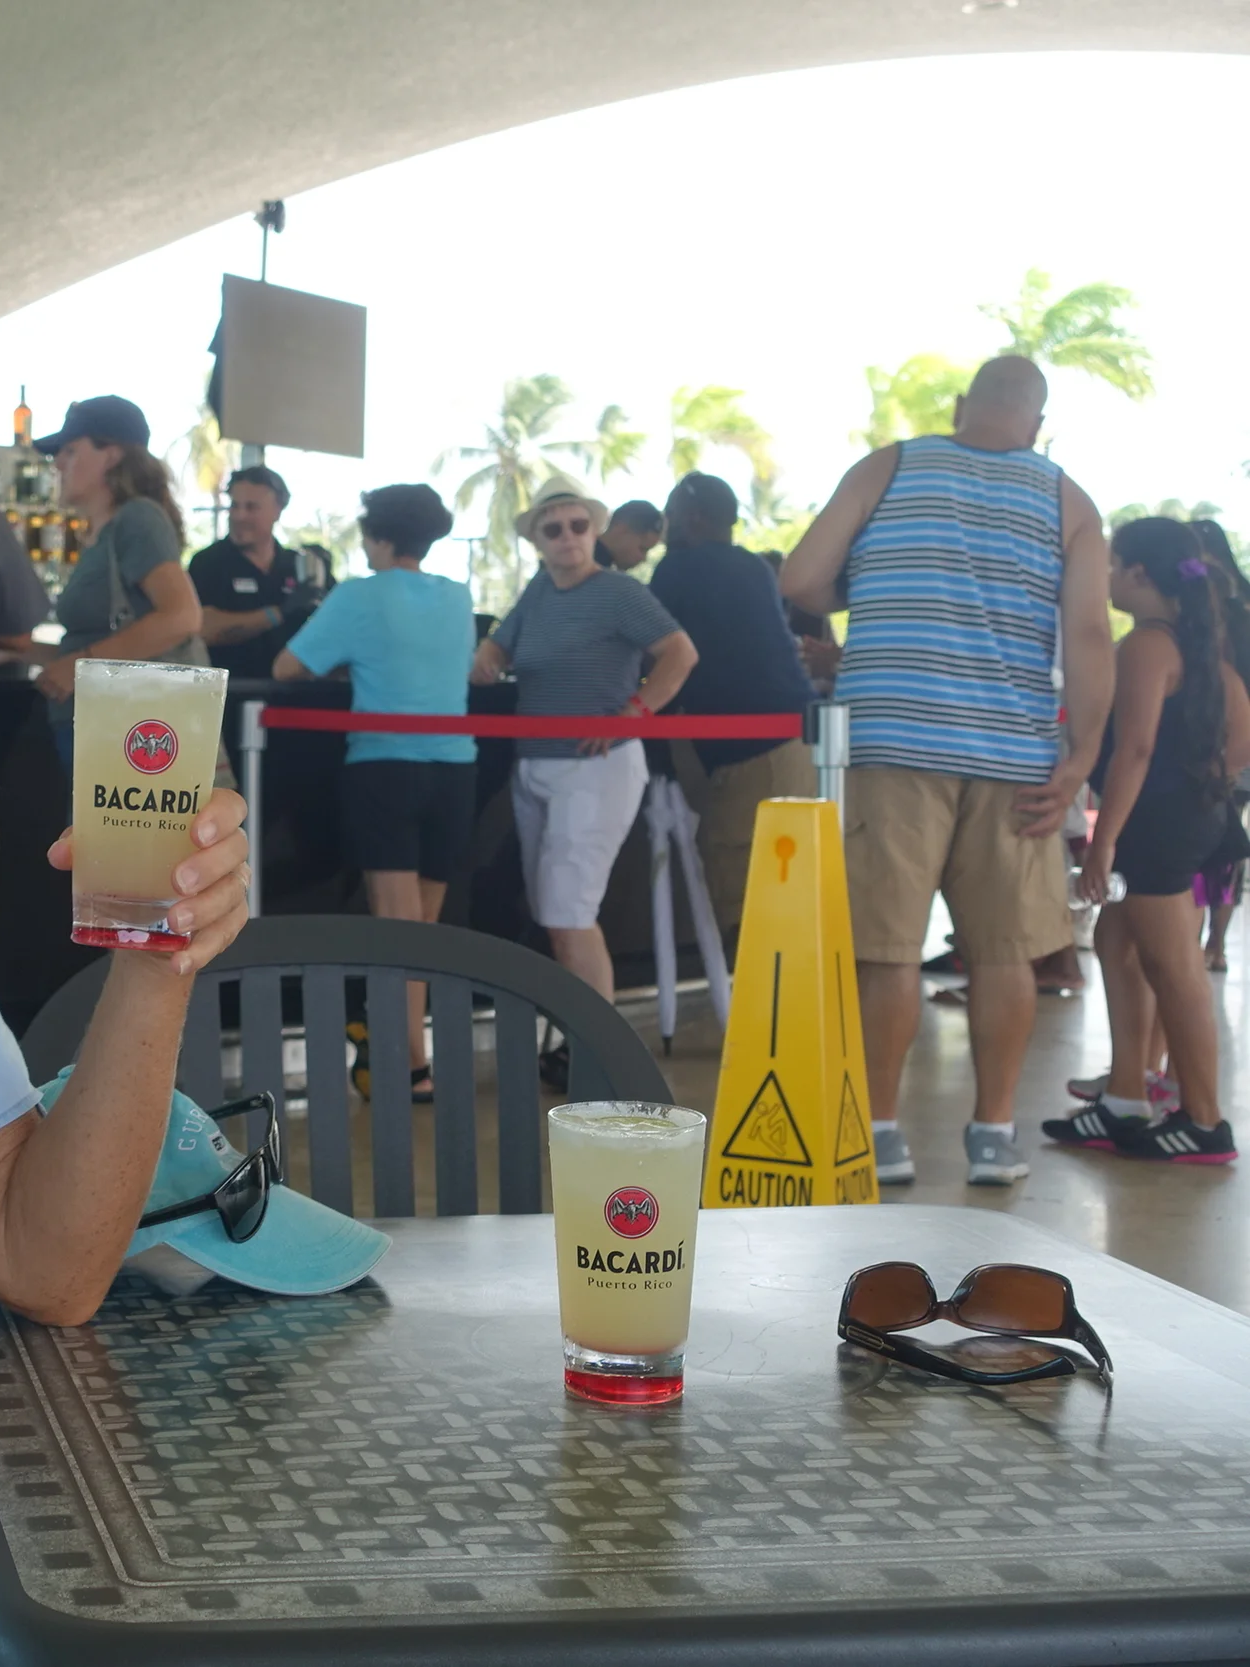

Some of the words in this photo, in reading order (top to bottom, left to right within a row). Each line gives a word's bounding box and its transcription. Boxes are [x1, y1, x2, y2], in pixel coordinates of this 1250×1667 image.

[94, 783, 200, 814] BACARDÍ
[103, 815, 152, 829] Puerto
[158, 819, 187, 832] Rico
[720, 1167, 813, 1206] CAUTION
[577, 1240, 684, 1274] BACARDÍ
[587, 1276, 637, 1290] Puerto
[644, 1279, 673, 1290] Rico
